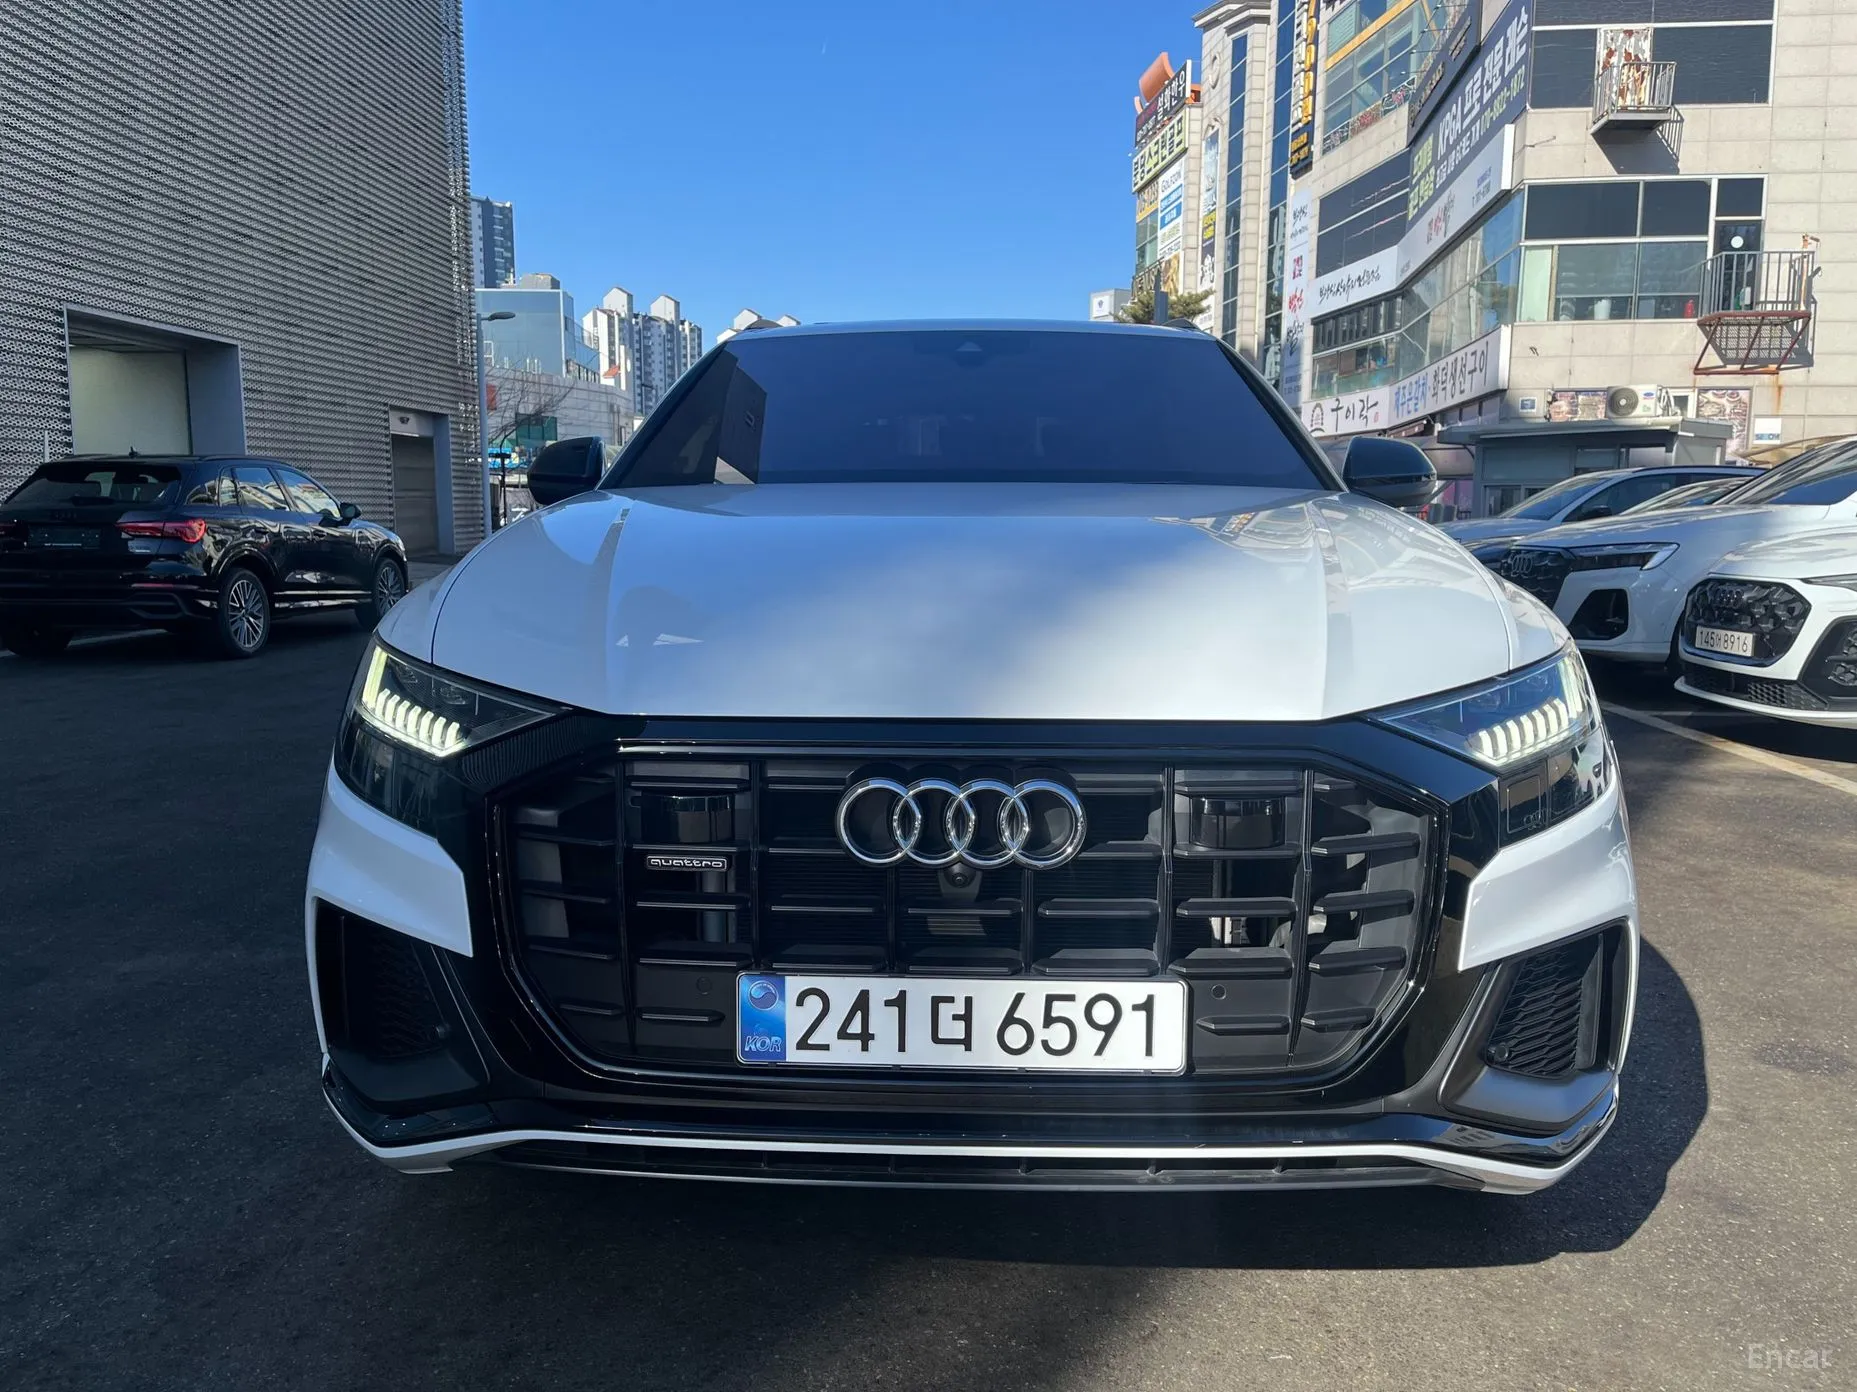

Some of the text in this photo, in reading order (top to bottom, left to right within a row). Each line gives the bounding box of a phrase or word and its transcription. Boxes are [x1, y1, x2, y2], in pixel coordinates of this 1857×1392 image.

[1438, 96, 1461, 160] KPGA
[1462, 67, 1482, 129] 프로
[1483, 36, 1504, 104] 전문
[1505, 6, 1528, 77] 레슨
[650, 859, 722, 867] quattro
[745, 1036, 782, 1052] KOR
